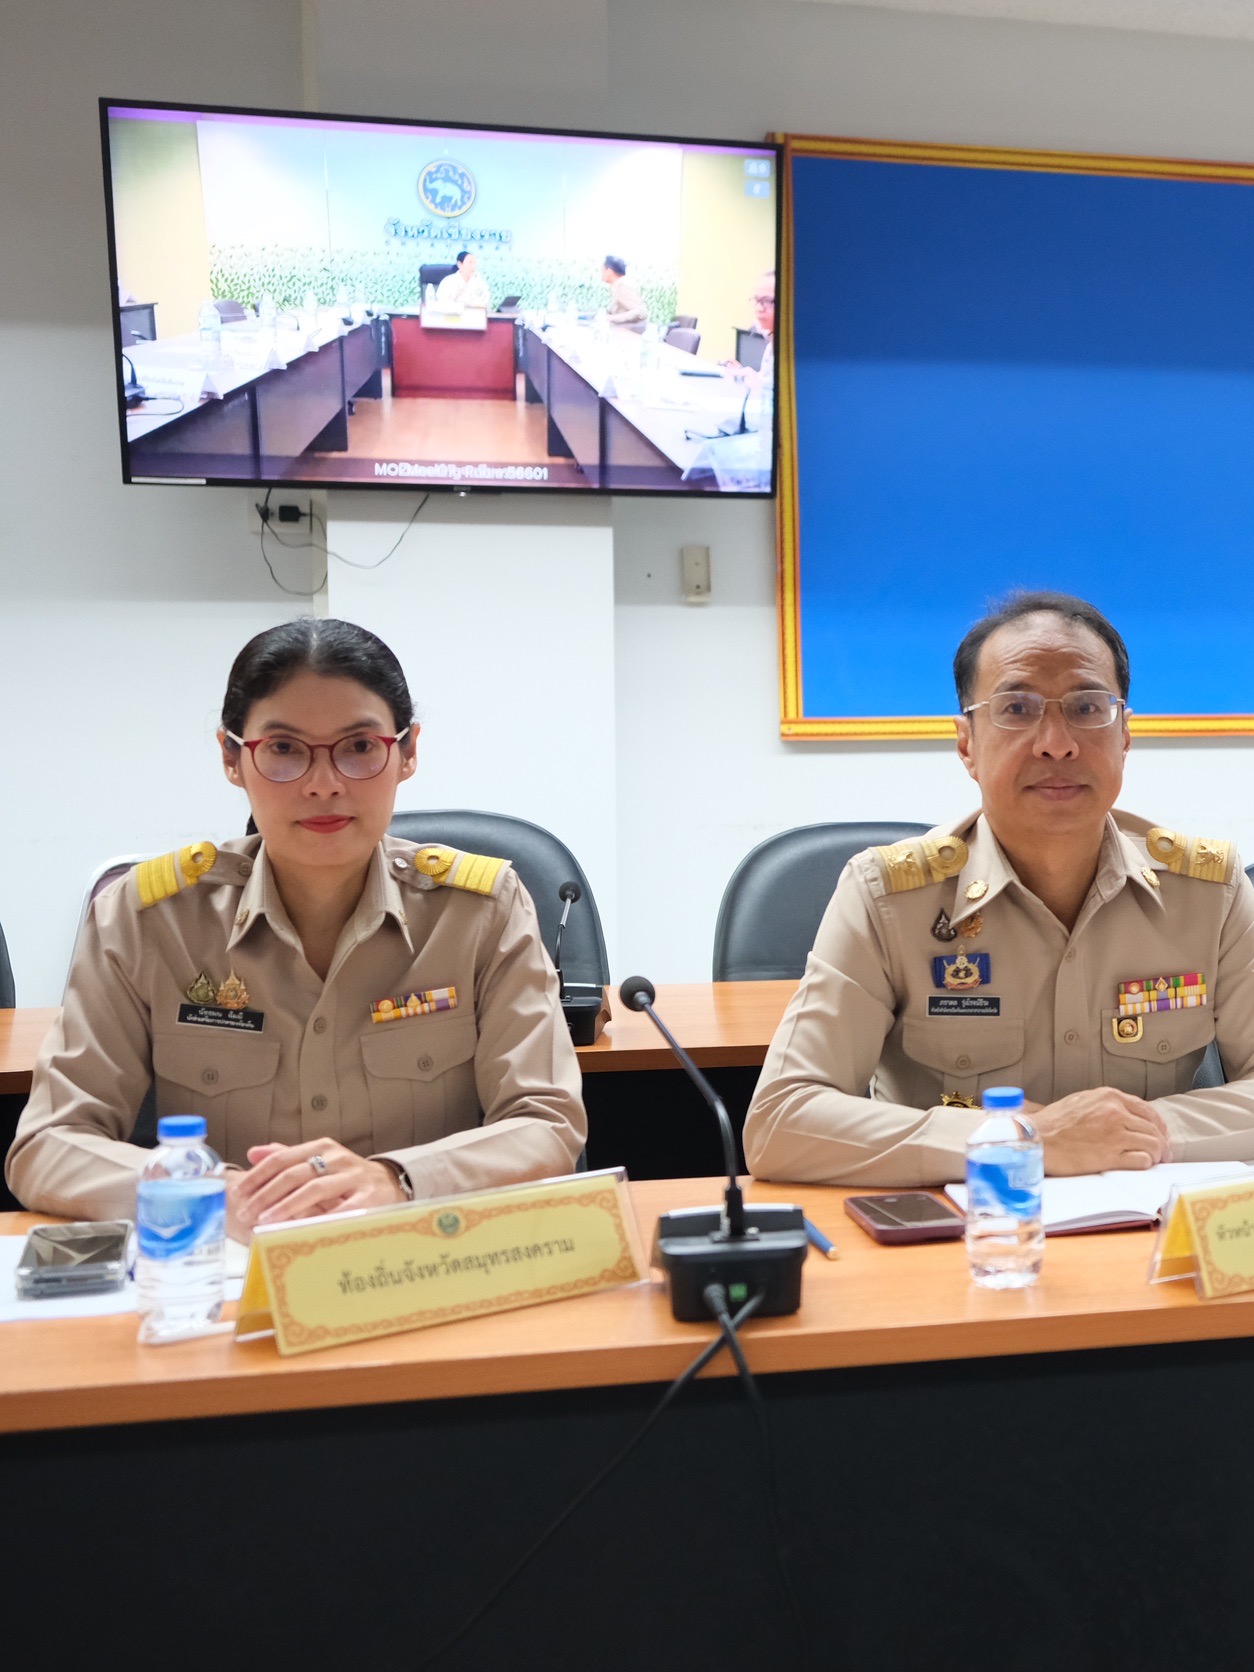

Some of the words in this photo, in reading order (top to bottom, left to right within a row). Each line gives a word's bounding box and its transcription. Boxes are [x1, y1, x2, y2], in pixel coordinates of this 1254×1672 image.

[337, 1237, 576, 1295] ท้องถิ่นจังหวัดสมุทรสงคราม
